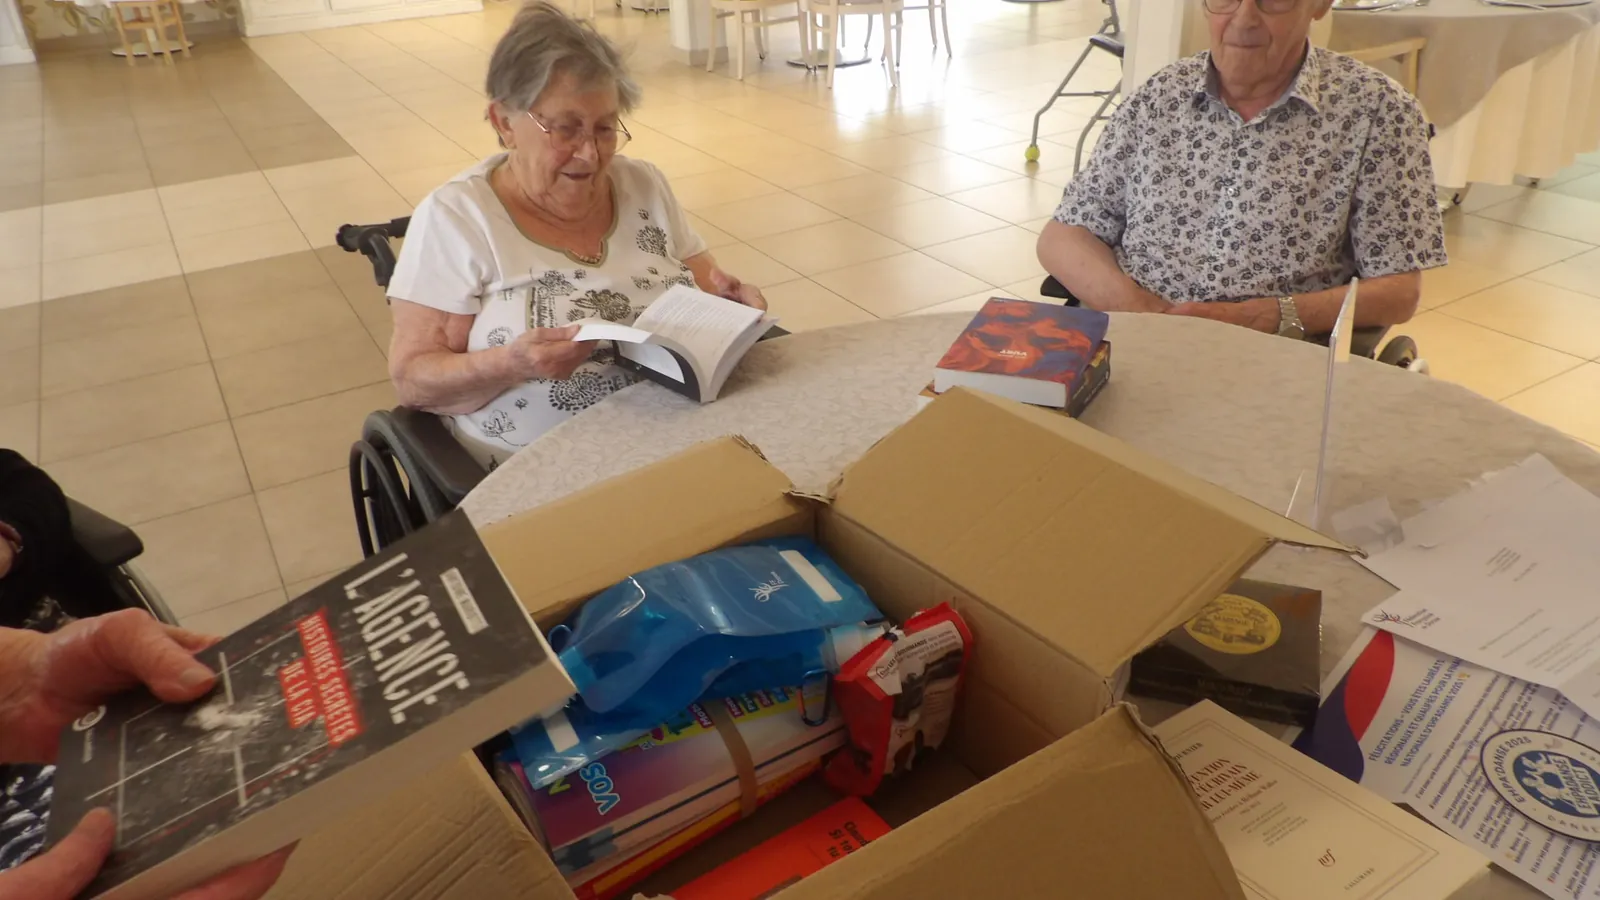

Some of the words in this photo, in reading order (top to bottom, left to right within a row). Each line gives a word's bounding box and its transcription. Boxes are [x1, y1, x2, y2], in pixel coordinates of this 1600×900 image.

[299, 614, 338, 681] HISTOIRES
[344, 552, 470, 725] L'AGENCE
[280, 659, 306, 683] DE
[285, 678, 311, 702] LA
[289, 696, 317, 726] CIA
[1385, 730, 1414, 764] RÉGIONAUX
[1434, 681, 1448, 695] POUR
[1369, 718, 1404, 761] FÉLICITATIONS
[1403, 698, 1418, 714] VOUS
[1401, 734, 1429, 767] NATIONALE
[579, 762, 620, 816] VOS
[1196, 764, 1247, 797] 'ÉCRIVAIN
[1344, 868, 1376, 892] GALLIMARD
